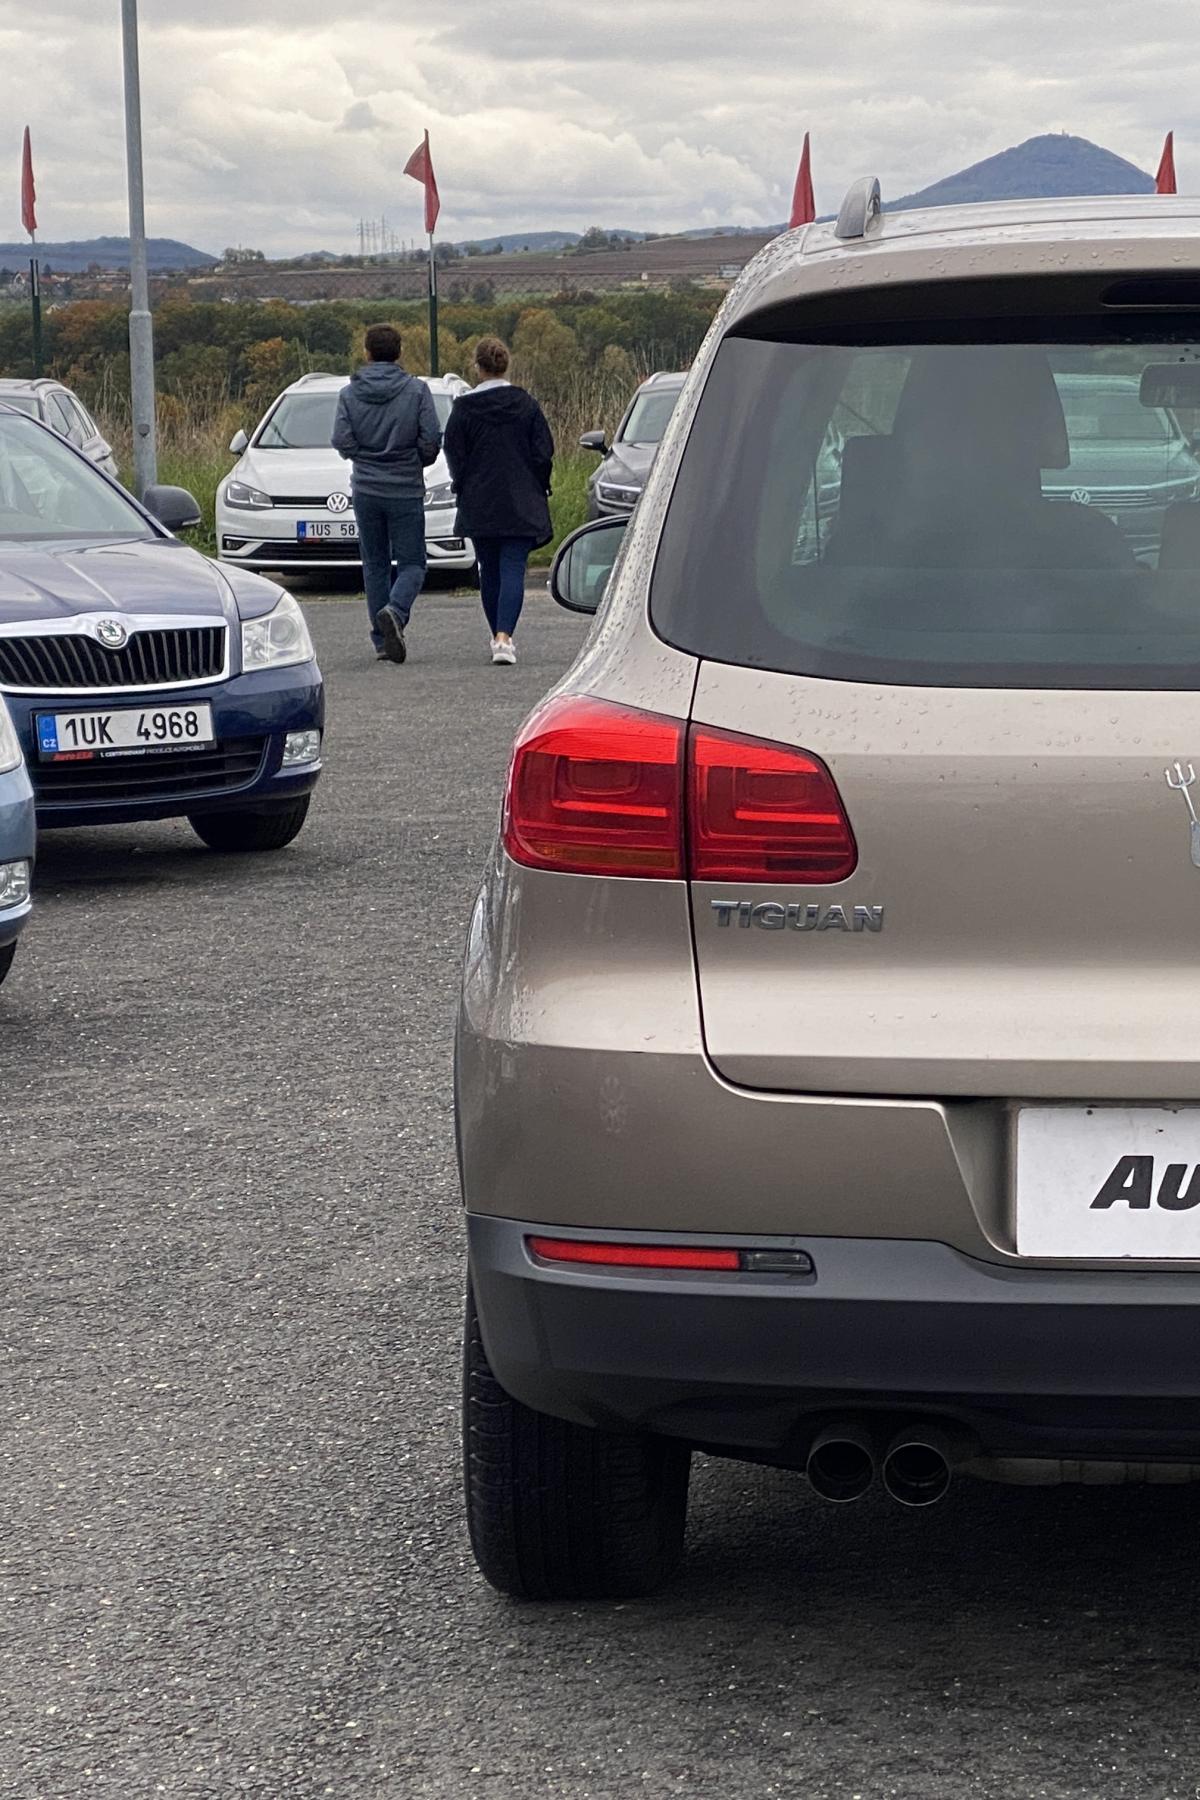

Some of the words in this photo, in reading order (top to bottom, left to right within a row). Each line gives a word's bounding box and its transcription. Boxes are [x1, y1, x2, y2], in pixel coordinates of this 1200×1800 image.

[310, 524, 331, 536] 1US
[340, 524, 355, 536] 58
[65, 716, 114, 745] 1UK
[137, 711, 198, 741] 4968
[43, 739, 56, 748] CZ
[711, 900, 883, 932] TIGUAN
